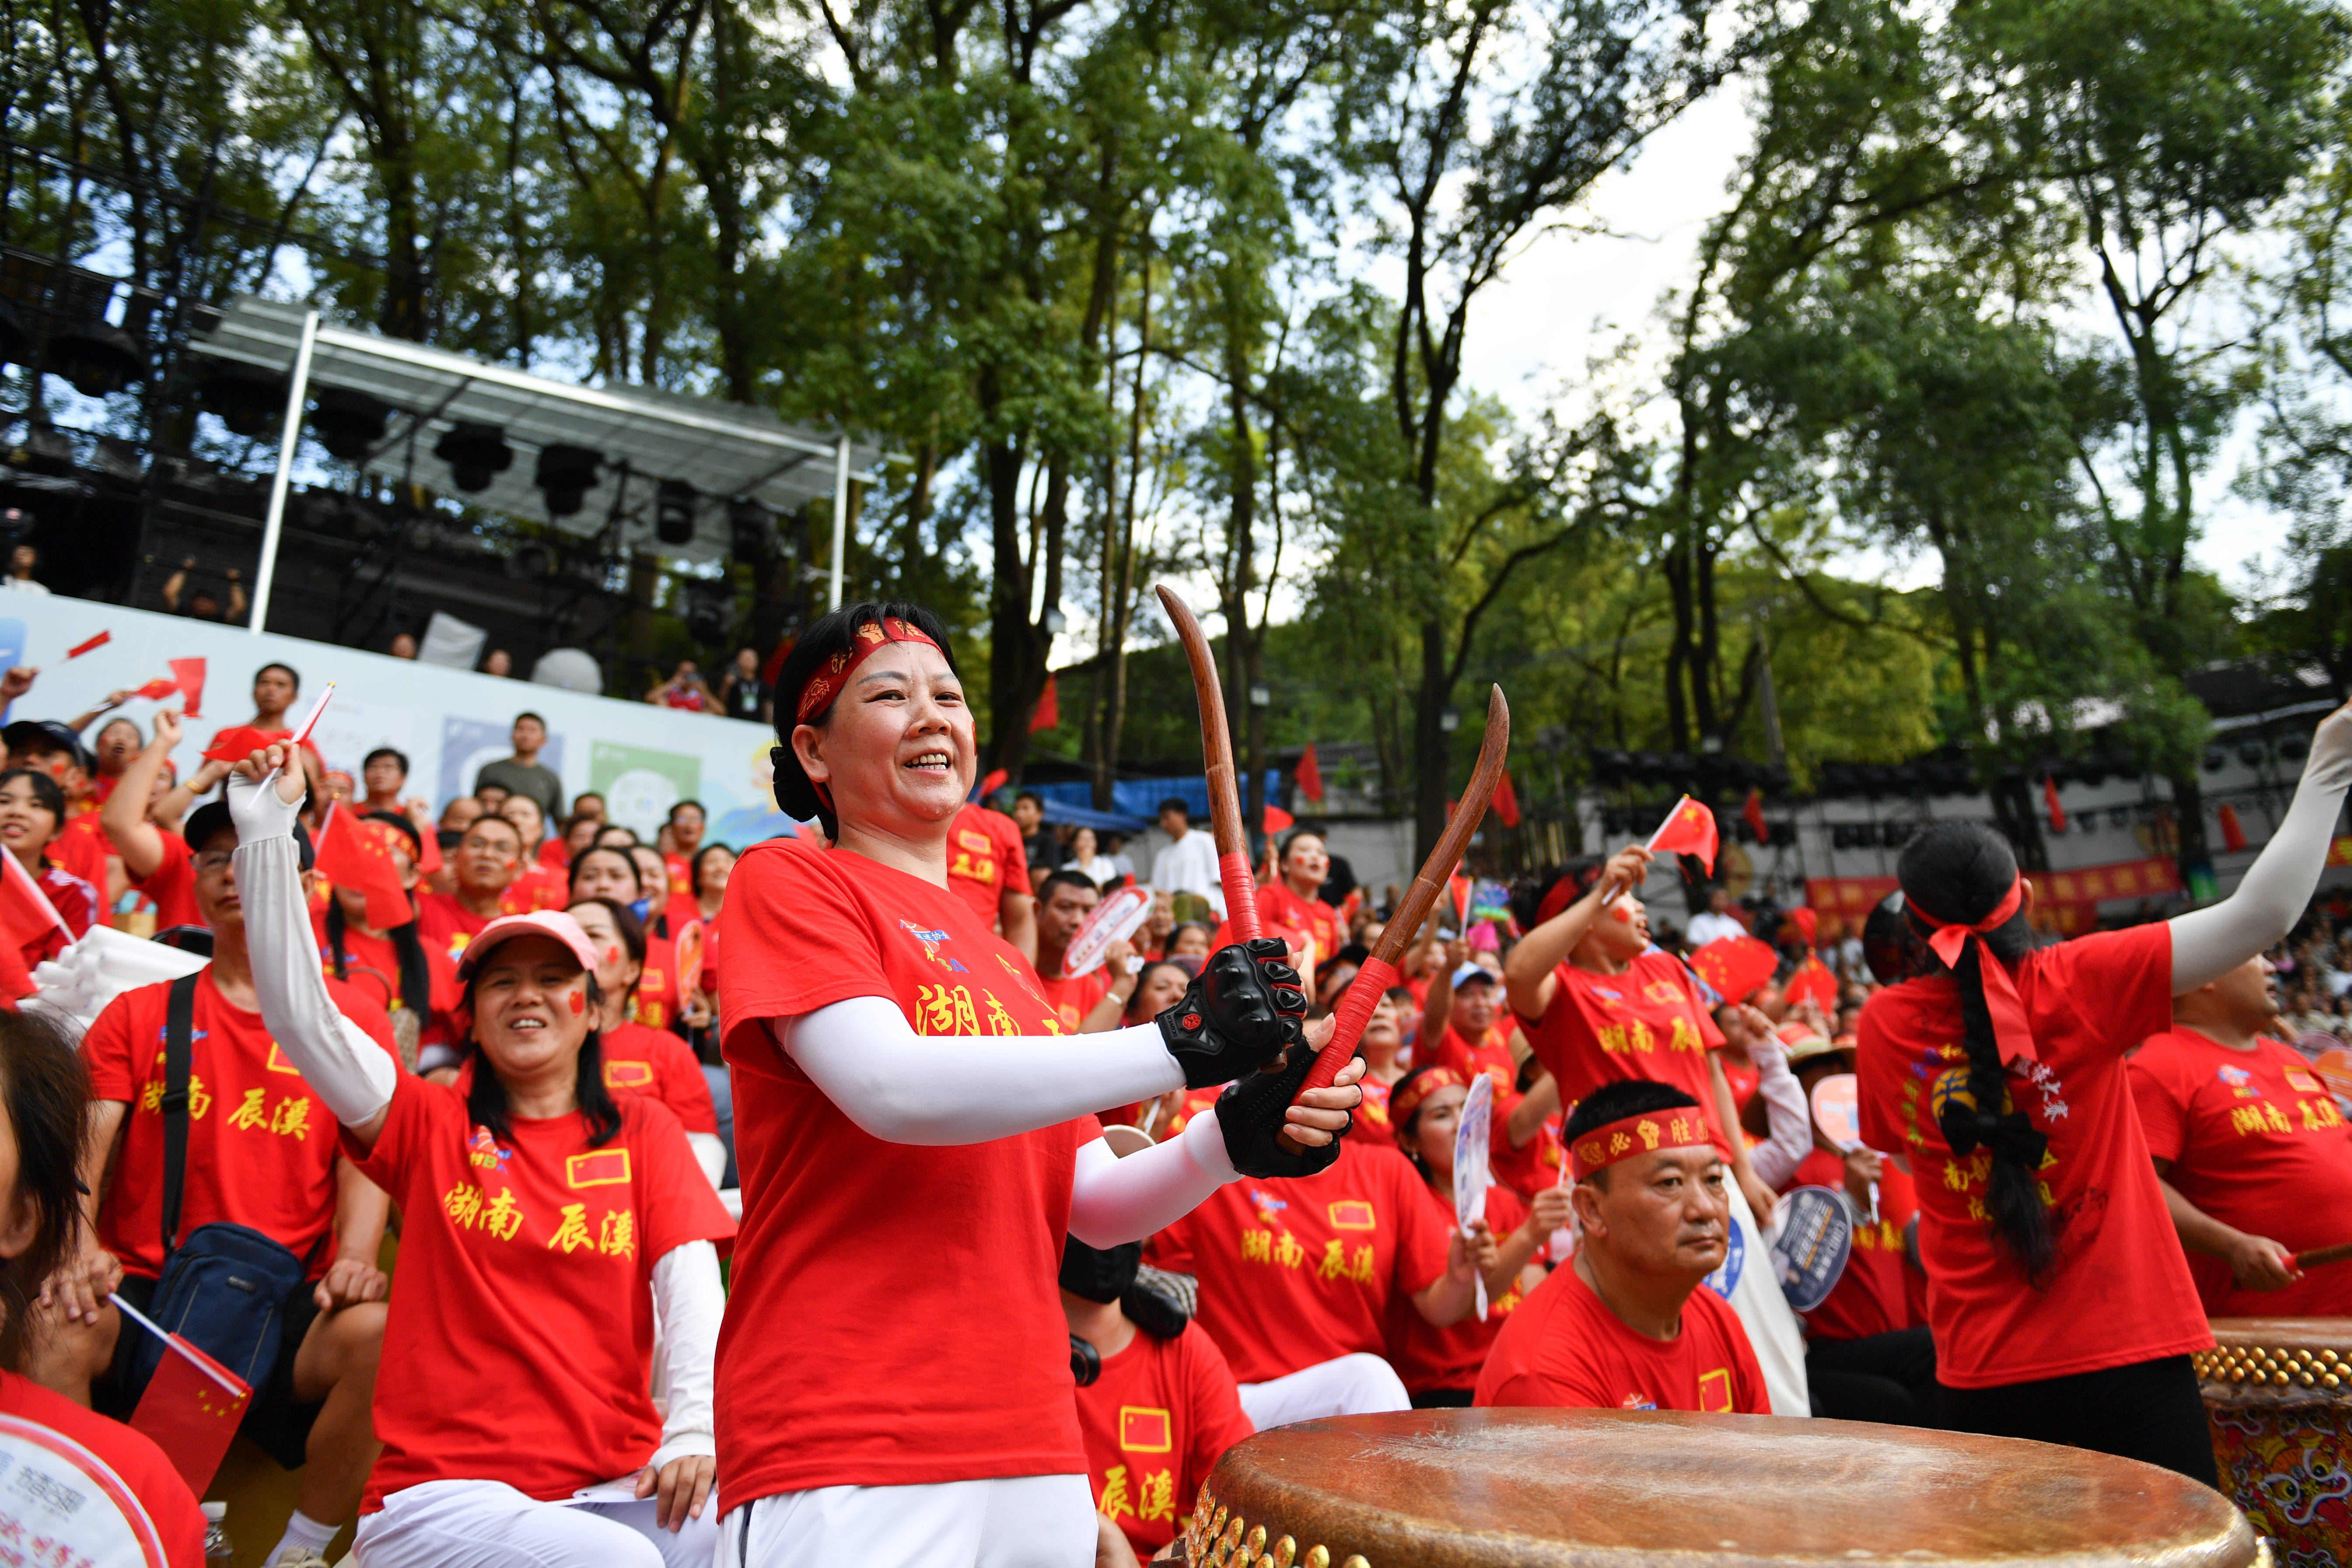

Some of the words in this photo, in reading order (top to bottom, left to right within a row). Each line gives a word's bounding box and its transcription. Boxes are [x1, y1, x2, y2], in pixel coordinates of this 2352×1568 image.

[227, 1087, 311, 1141] 辰溪
[1609, 1131, 1631, 1157] 必
[1670, 1116, 1693, 1144] 胜
[444, 1180, 524, 1241] 湖南
[548, 1203, 636, 1262] 辰溪
[1241, 1228, 1304, 1270] 湖南
[1317, 1238, 1375, 1286] 辰溪
[1098, 1463, 1176, 1523] 辰溪
